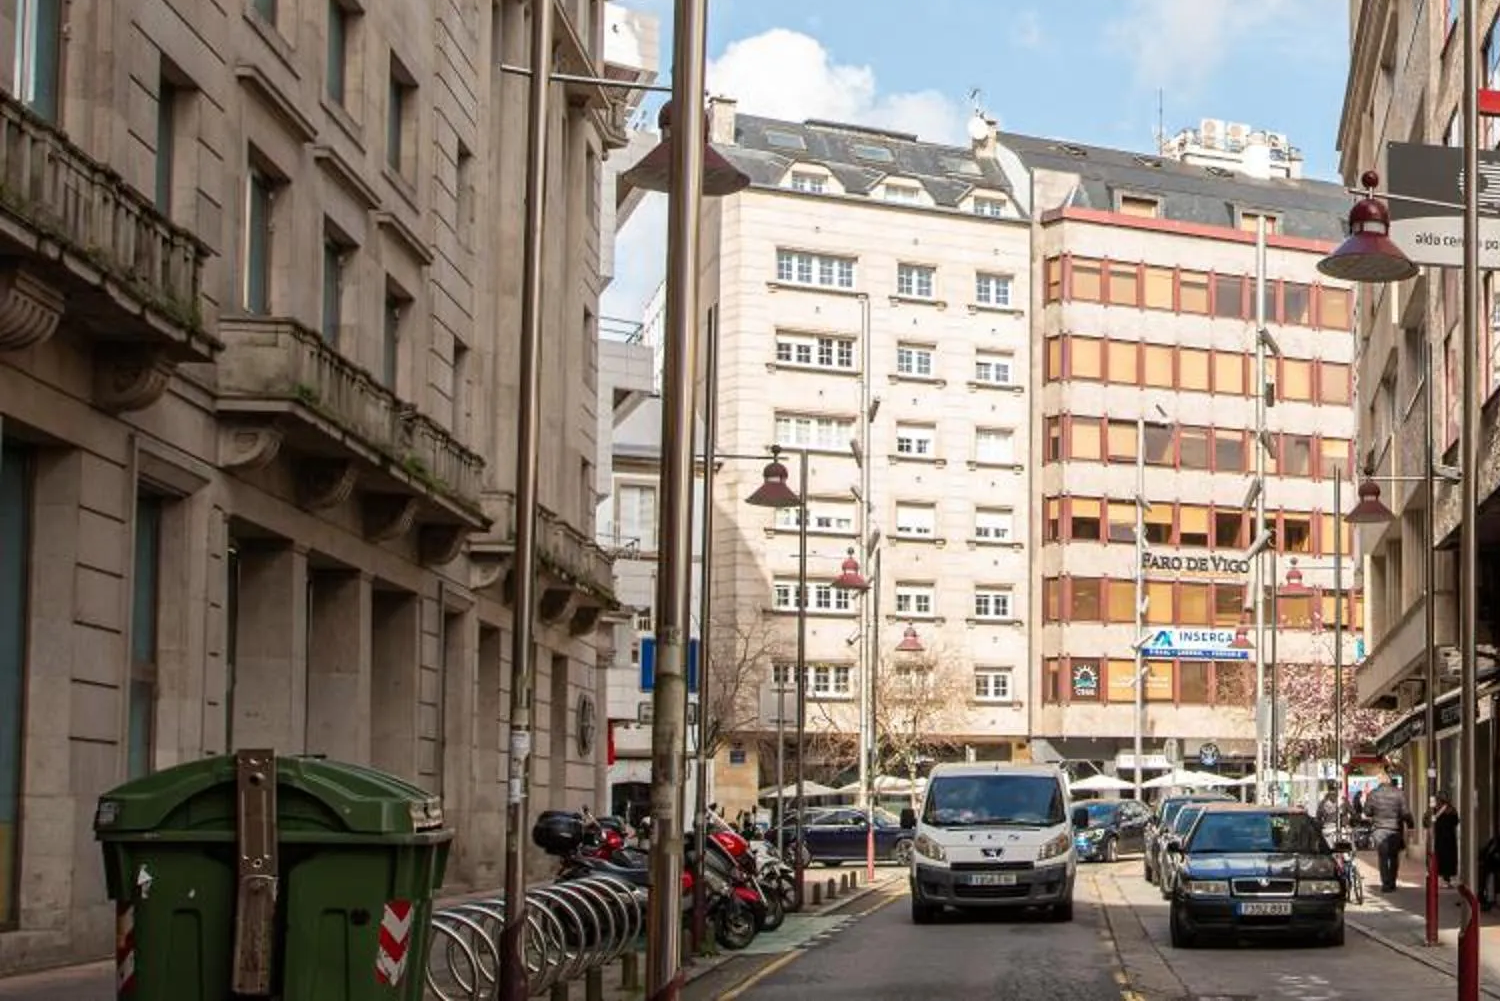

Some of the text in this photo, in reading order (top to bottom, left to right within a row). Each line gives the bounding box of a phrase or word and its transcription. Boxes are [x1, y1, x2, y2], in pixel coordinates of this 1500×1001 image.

[1415, 233, 1441, 246] alda
[1141, 552, 1250, 573] FARO DE VIGO
